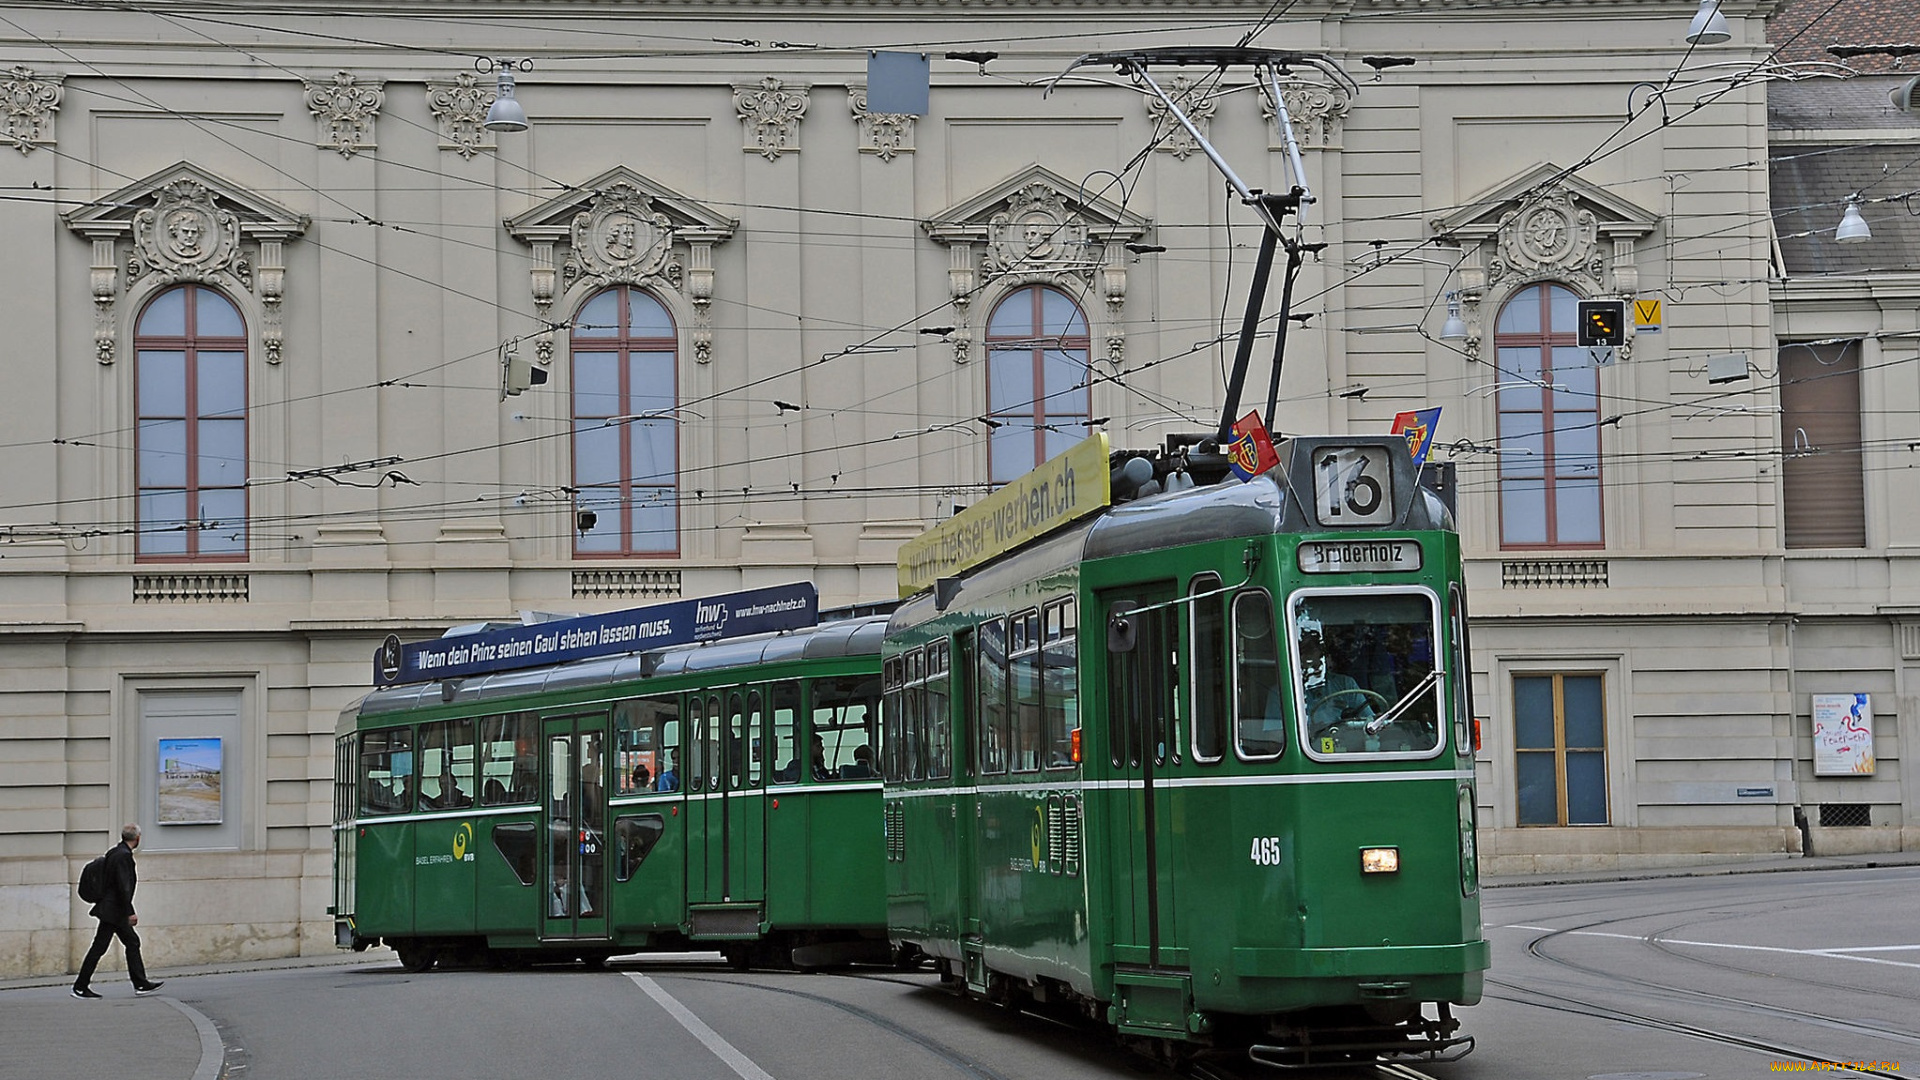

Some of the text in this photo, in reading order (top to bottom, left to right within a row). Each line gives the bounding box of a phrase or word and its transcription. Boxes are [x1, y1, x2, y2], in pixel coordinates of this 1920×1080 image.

[1596, 338, 1607, 346] 13
[1320, 454, 1383, 516] 16
[909, 457, 1075, 585] www.besser-werben.ch
[418, 619, 672, 670] Wenn dein Prinz seinen Gaul stehen lassen muss.
[1250, 837, 1281, 866] 465
